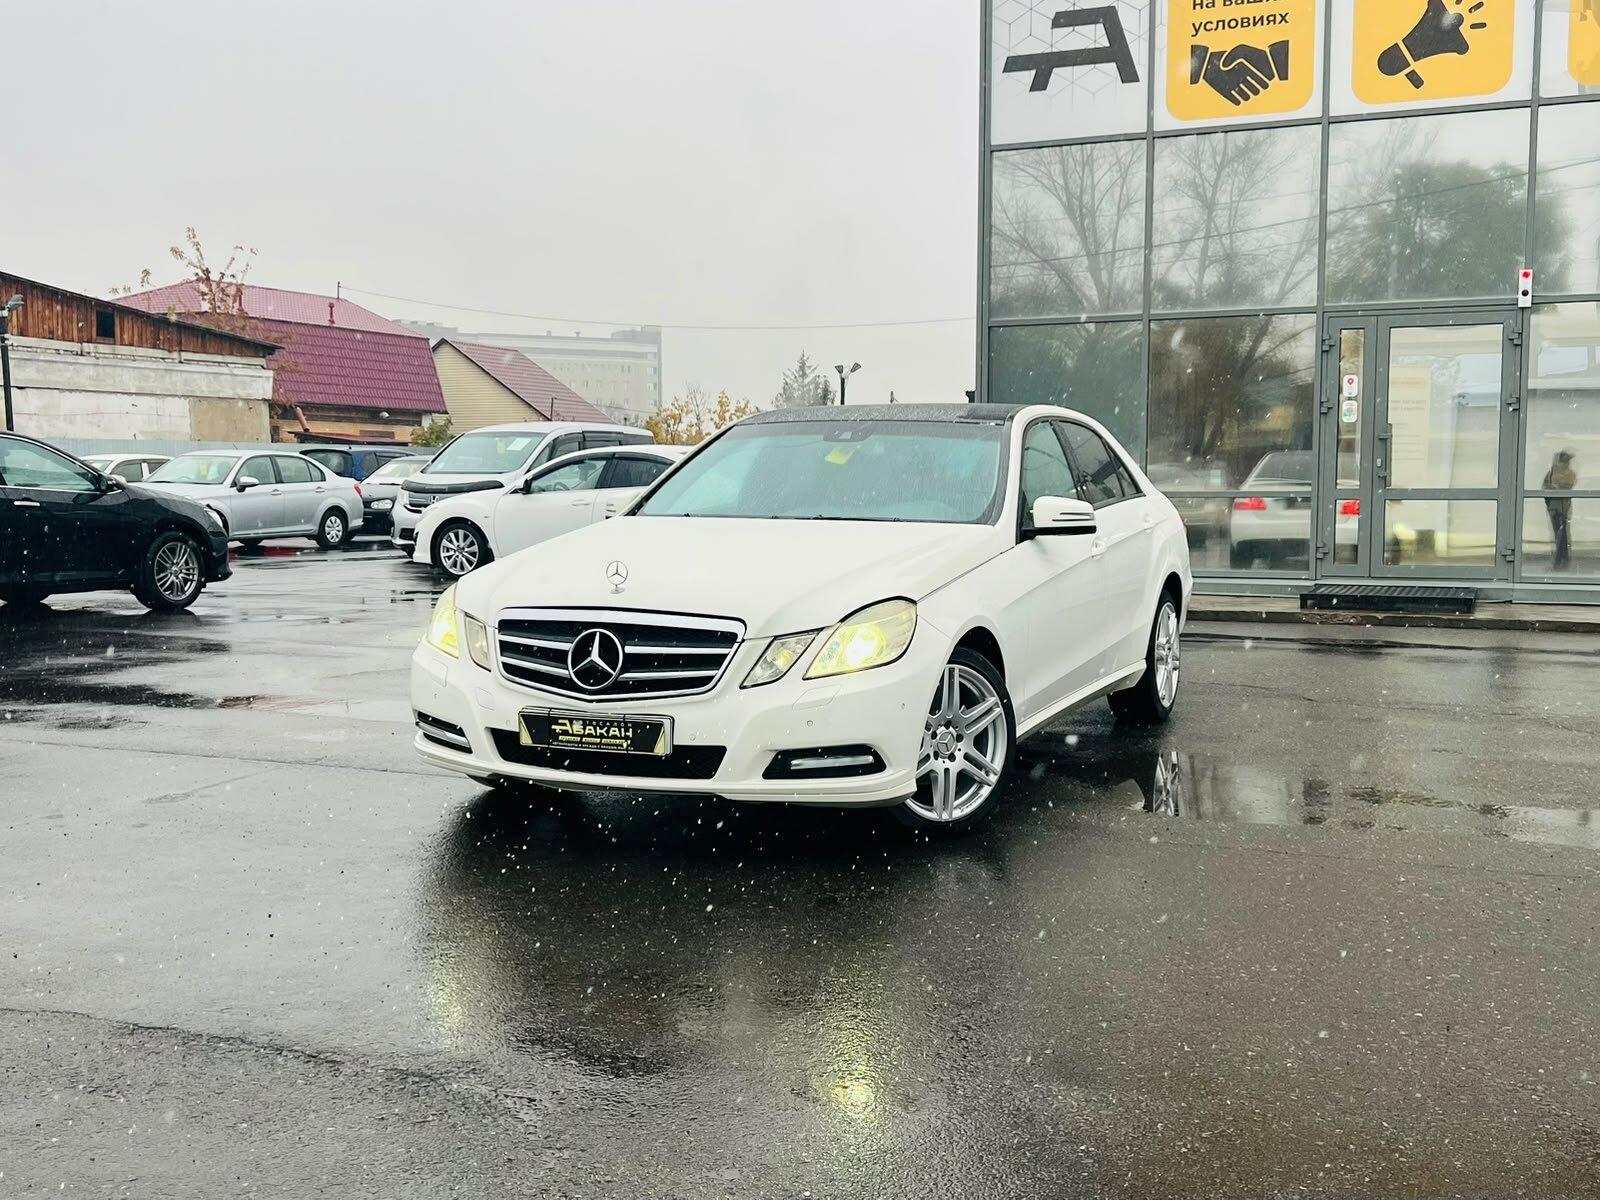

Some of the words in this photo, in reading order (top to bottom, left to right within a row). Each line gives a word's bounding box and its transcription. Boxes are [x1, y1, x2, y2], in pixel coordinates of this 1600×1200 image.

[1192, 0, 1216, 10] на
[1191, 12, 1290, 37] условиях
[551, 719, 633, 738] АБАКАН
